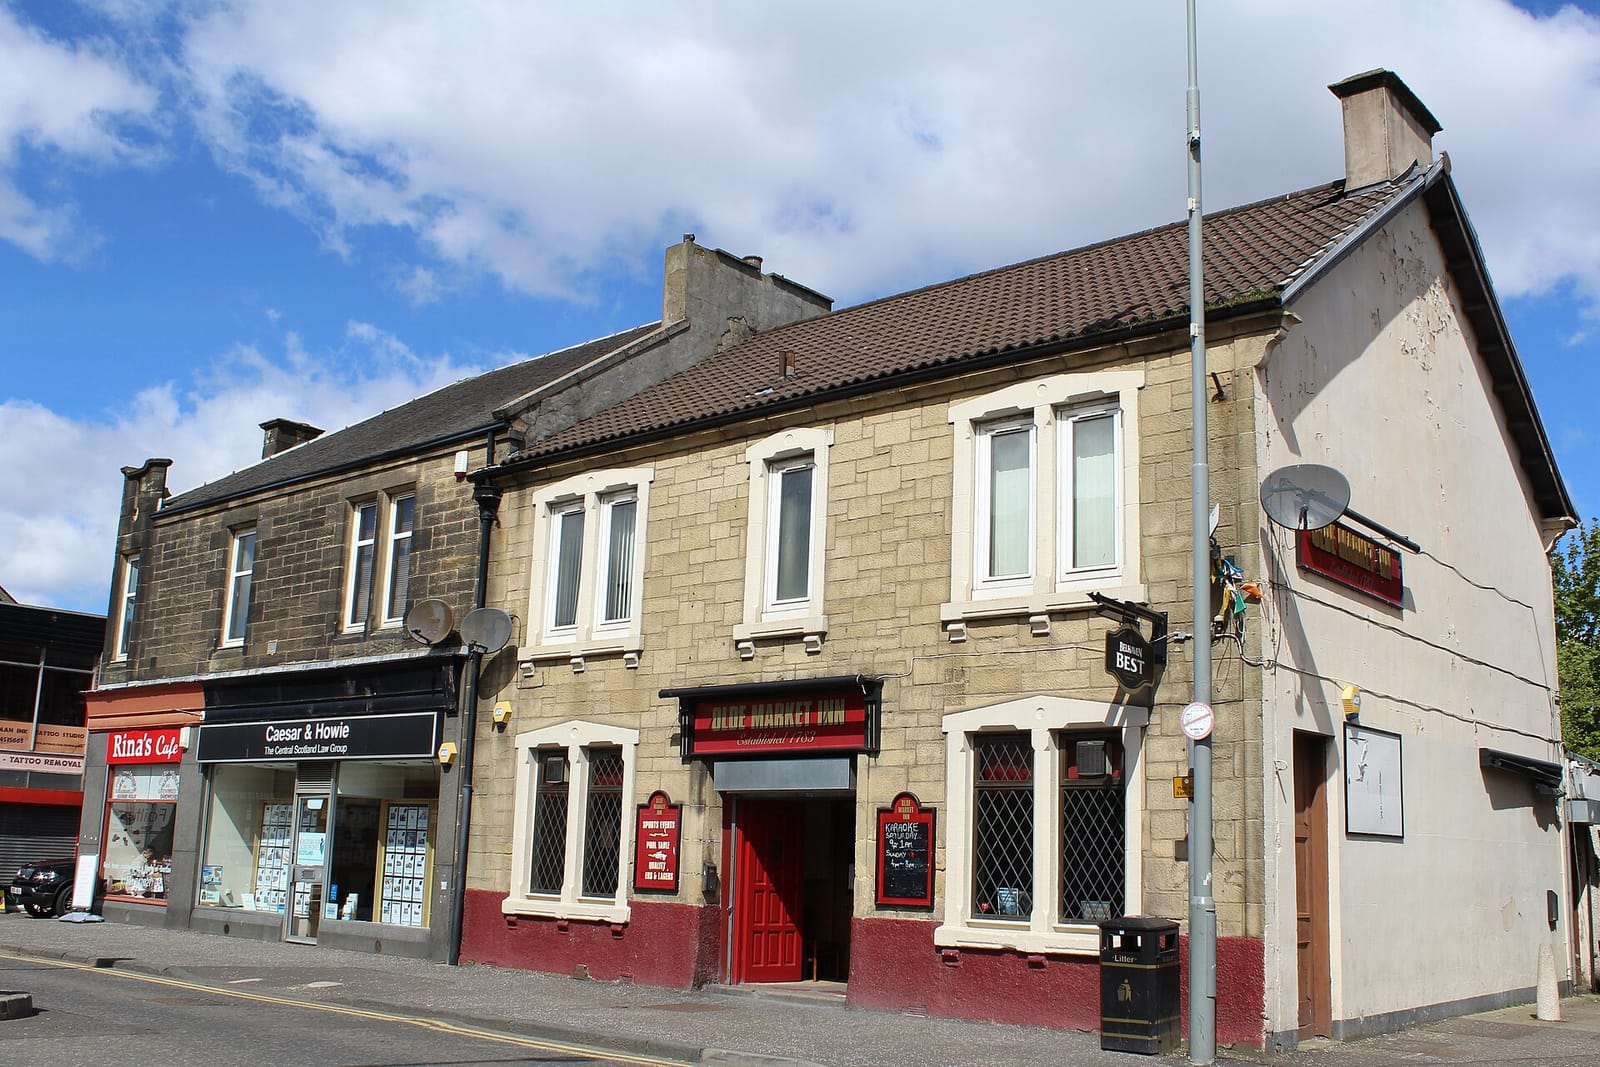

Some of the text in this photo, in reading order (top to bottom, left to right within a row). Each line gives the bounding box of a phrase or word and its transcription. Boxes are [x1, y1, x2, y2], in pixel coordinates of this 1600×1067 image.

[1116, 652, 1145, 675] BEST
[711, 699, 845, 731] OLDE MARKET INN
[265, 722, 350, 742] Caesar & Howie
[112, 733, 153, 758] Rina's
[264, 743, 348, 755] The Central Scotland Law Group
[9, 756, 41, 765] TATTOO
[44, 759, 82, 768] REMOVAL
[885, 822, 919, 833] KARAOKE
[1114, 954, 1134, 963] Litter
